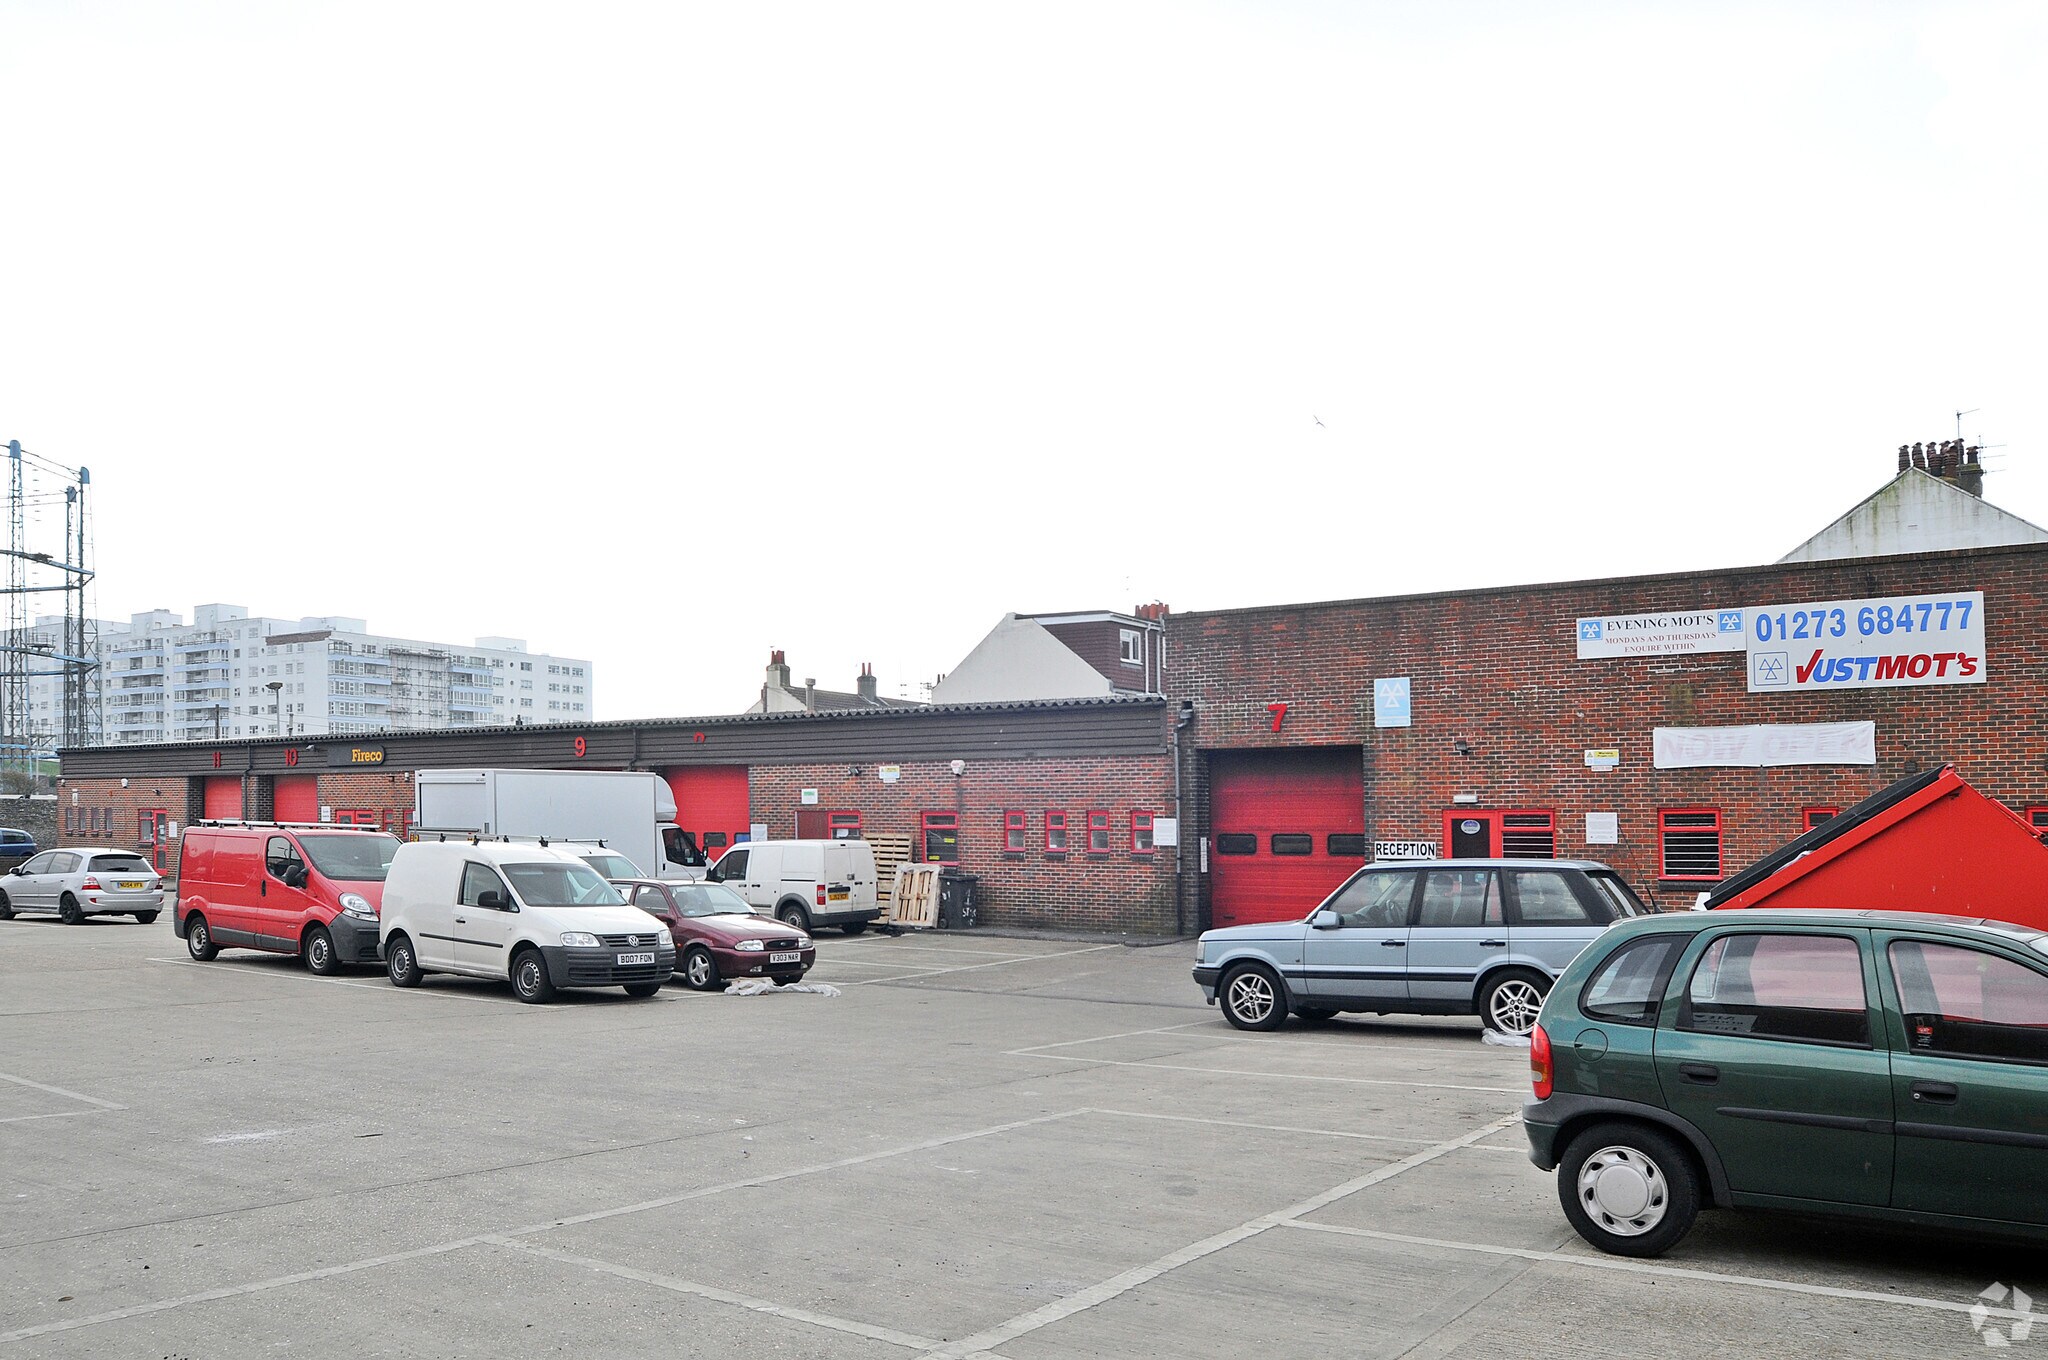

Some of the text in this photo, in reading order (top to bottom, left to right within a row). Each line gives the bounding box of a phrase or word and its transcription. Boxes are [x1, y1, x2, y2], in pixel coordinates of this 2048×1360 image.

[1607, 615, 1714, 631] EVENING MOT'S
[1756, 600, 1973, 642] 01273 684777
[1605, 632, 1717, 644] MONDAYS AND THURSDAYS
[1624, 642, 1696, 653] ENQUIRE WITHIN
[1267, 703, 1288, 733] 7
[574, 736, 586, 757] 9
[284, 747, 298, 766] 10
[351, 748, 383, 762] Fireco
[1375, 843, 1435, 856] RECEPTION
[620, 954, 638, 964] BD07
[772, 953, 799, 962] V303 NAR
